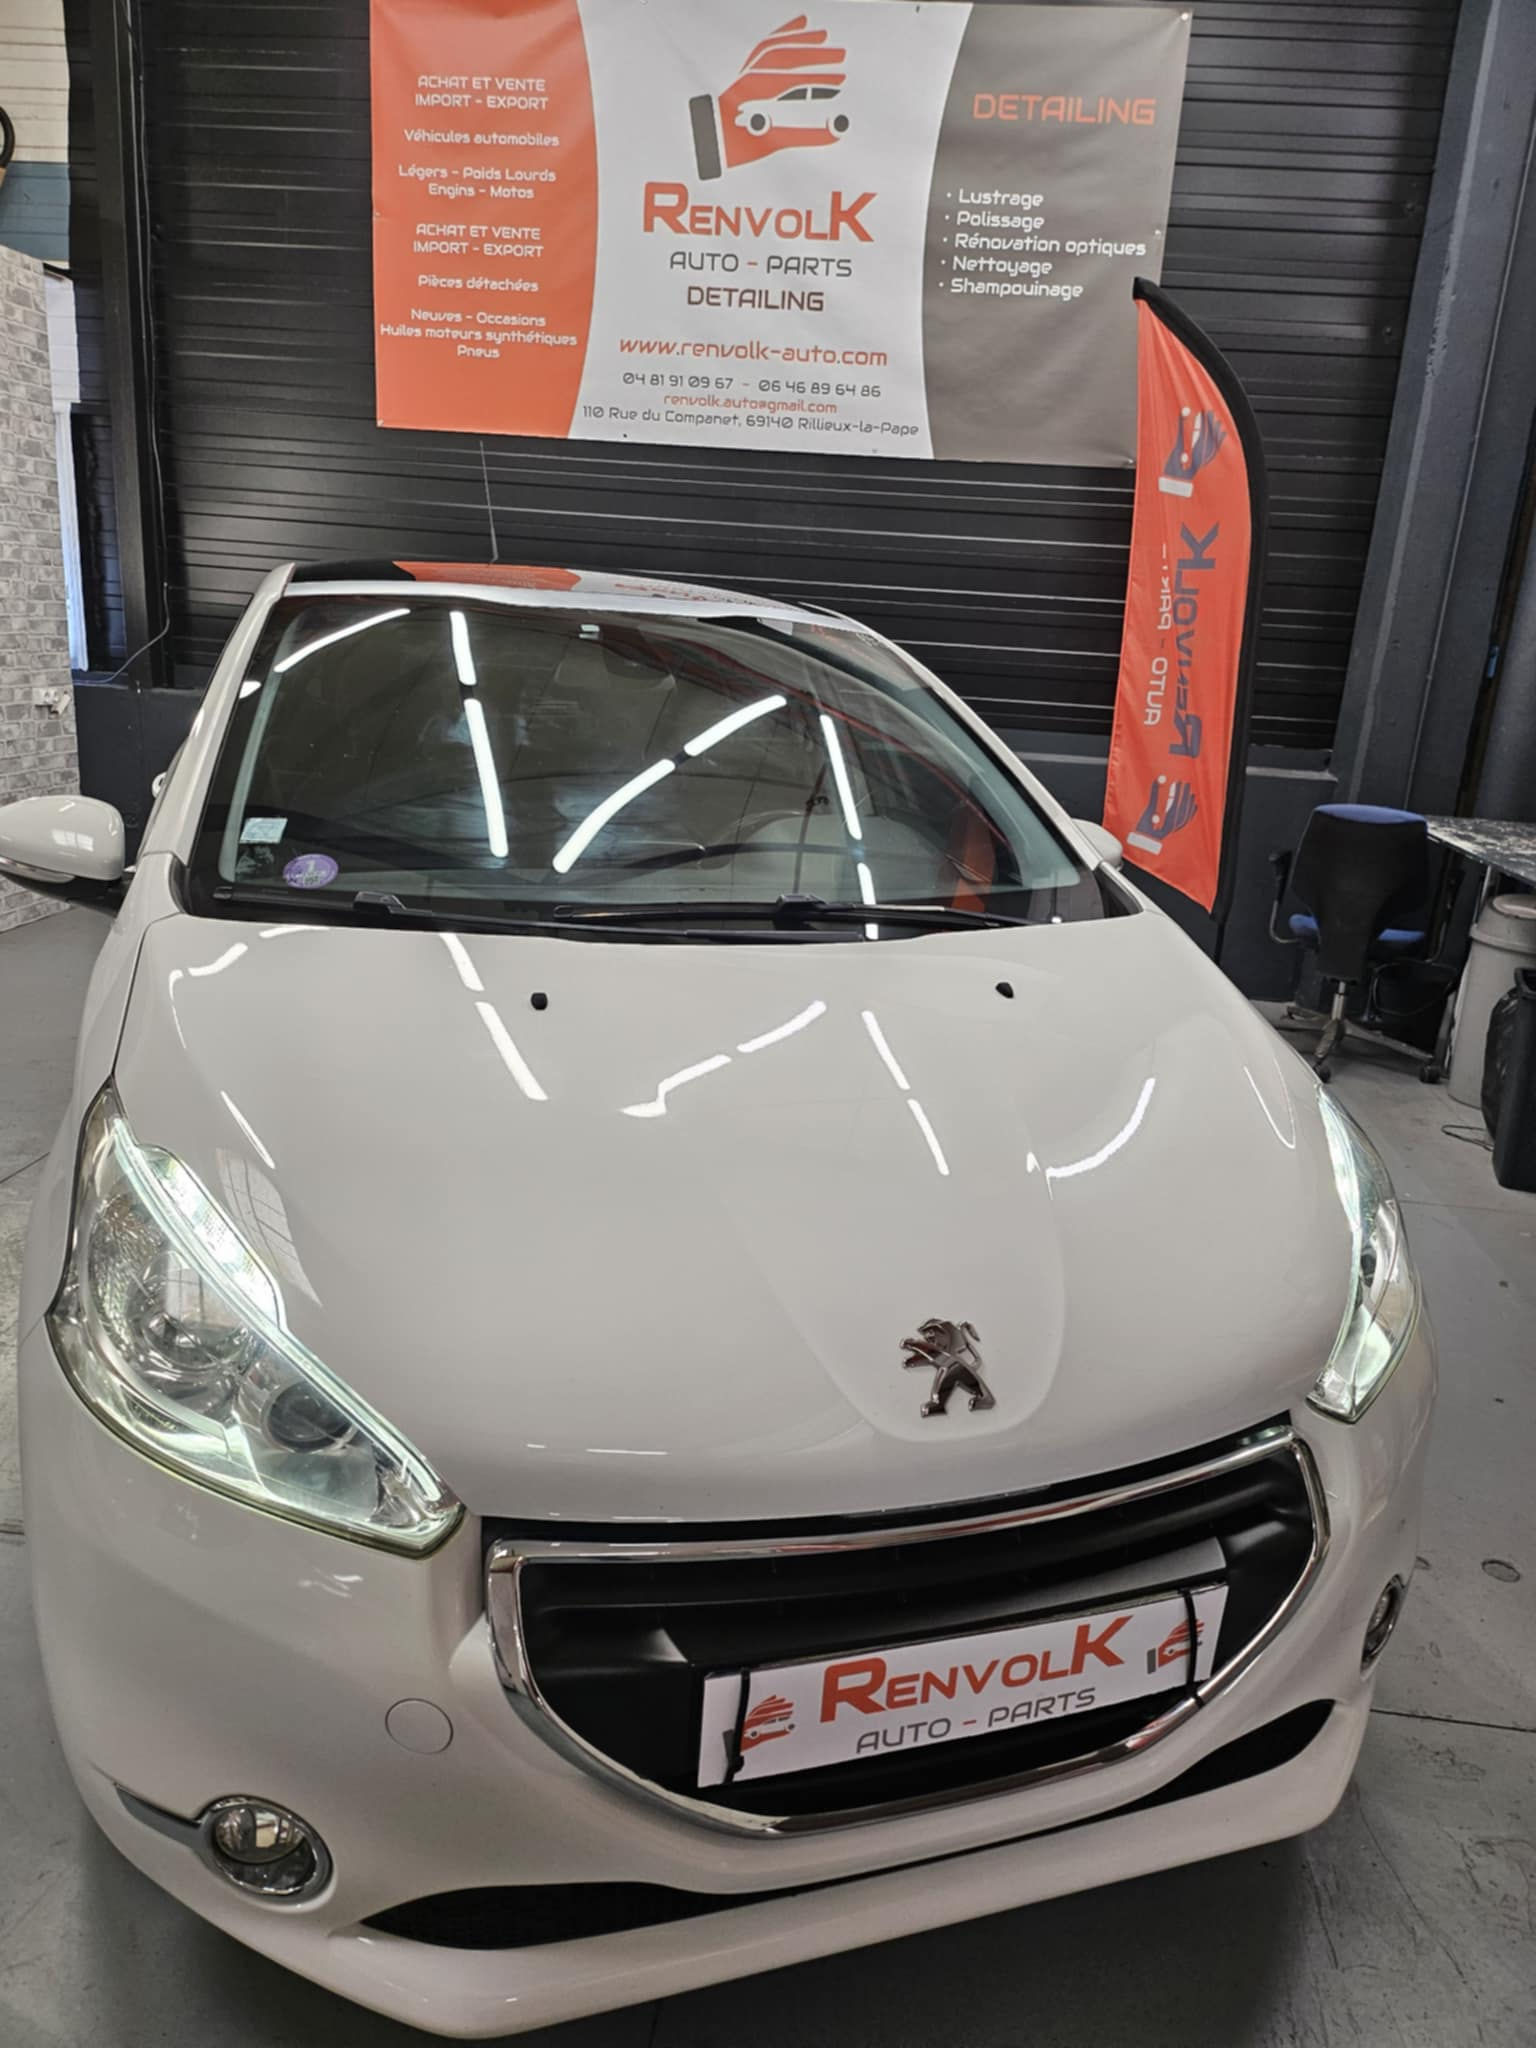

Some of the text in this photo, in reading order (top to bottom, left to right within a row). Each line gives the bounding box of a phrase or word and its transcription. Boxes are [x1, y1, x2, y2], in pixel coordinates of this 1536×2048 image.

[418, 75, 546, 92] ACHAT ET VENTE
[415, 93, 471, 107] IMPORT
[487, 95, 549, 110] EXPORT
[972, 93, 1157, 125] DETAILING
[404, 128, 560, 147] Véhicules automobiles
[398, 164, 448, 180] Légers
[463, 166, 502, 181] Poids
[505, 167, 557, 182] Lourds
[428, 183, 475, 199] Engins
[490, 185, 535, 199] Motos
[958, 188, 1044, 210] Lustrage
[416, 223, 541, 240] ACHAT ET VENTE
[956, 211, 1045, 232] Polissage
[413, 240, 469, 254] IMPORT
[483, 242, 545, 257] EXPORT
[954, 232, 1147, 257] Rénovation optiques
[670, 251, 739, 272] AUTO
[766, 255, 852, 277] PARTS
[953, 255, 1052, 277] Nettoyage
[418, 274, 539, 292] Pièces détachées
[950, 278, 1084, 301] Shampouinage
[687, 286, 824, 312] DETAILING
[411, 308, 462, 322] Neuves
[476, 311, 546, 327] Occasions
[380, 324, 578, 347] Huiles moteurs synthétiques
[457, 344, 500, 358] Pneus
[619, 338, 888, 366] www.renvolk-auto.com
[622, 372, 646, 385] 04
[650, 374, 664, 386] 81
[669, 375, 684, 387] 91
[688, 376, 710, 389] 09
[715, 377, 734, 390] 67
[758, 380, 781, 392] 06
[785, 381, 806, 394] 46
[810, 382, 831, 395] 89
[835, 384, 856, 396] 64
[860, 385, 881, 398] 86
[664, 394, 838, 414] renvolk.auto@gmail.com
[583, 406, 604, 419] 110
[608, 407, 638, 420] Rue
[642, 409, 661, 422] du
[746, 415, 793, 429] 69140
[798, 417, 919, 437] Rillieux-la-Pape
[856, 1717, 951, 1754] AUTO
[988, 1687, 1096, 1727] PARTS
